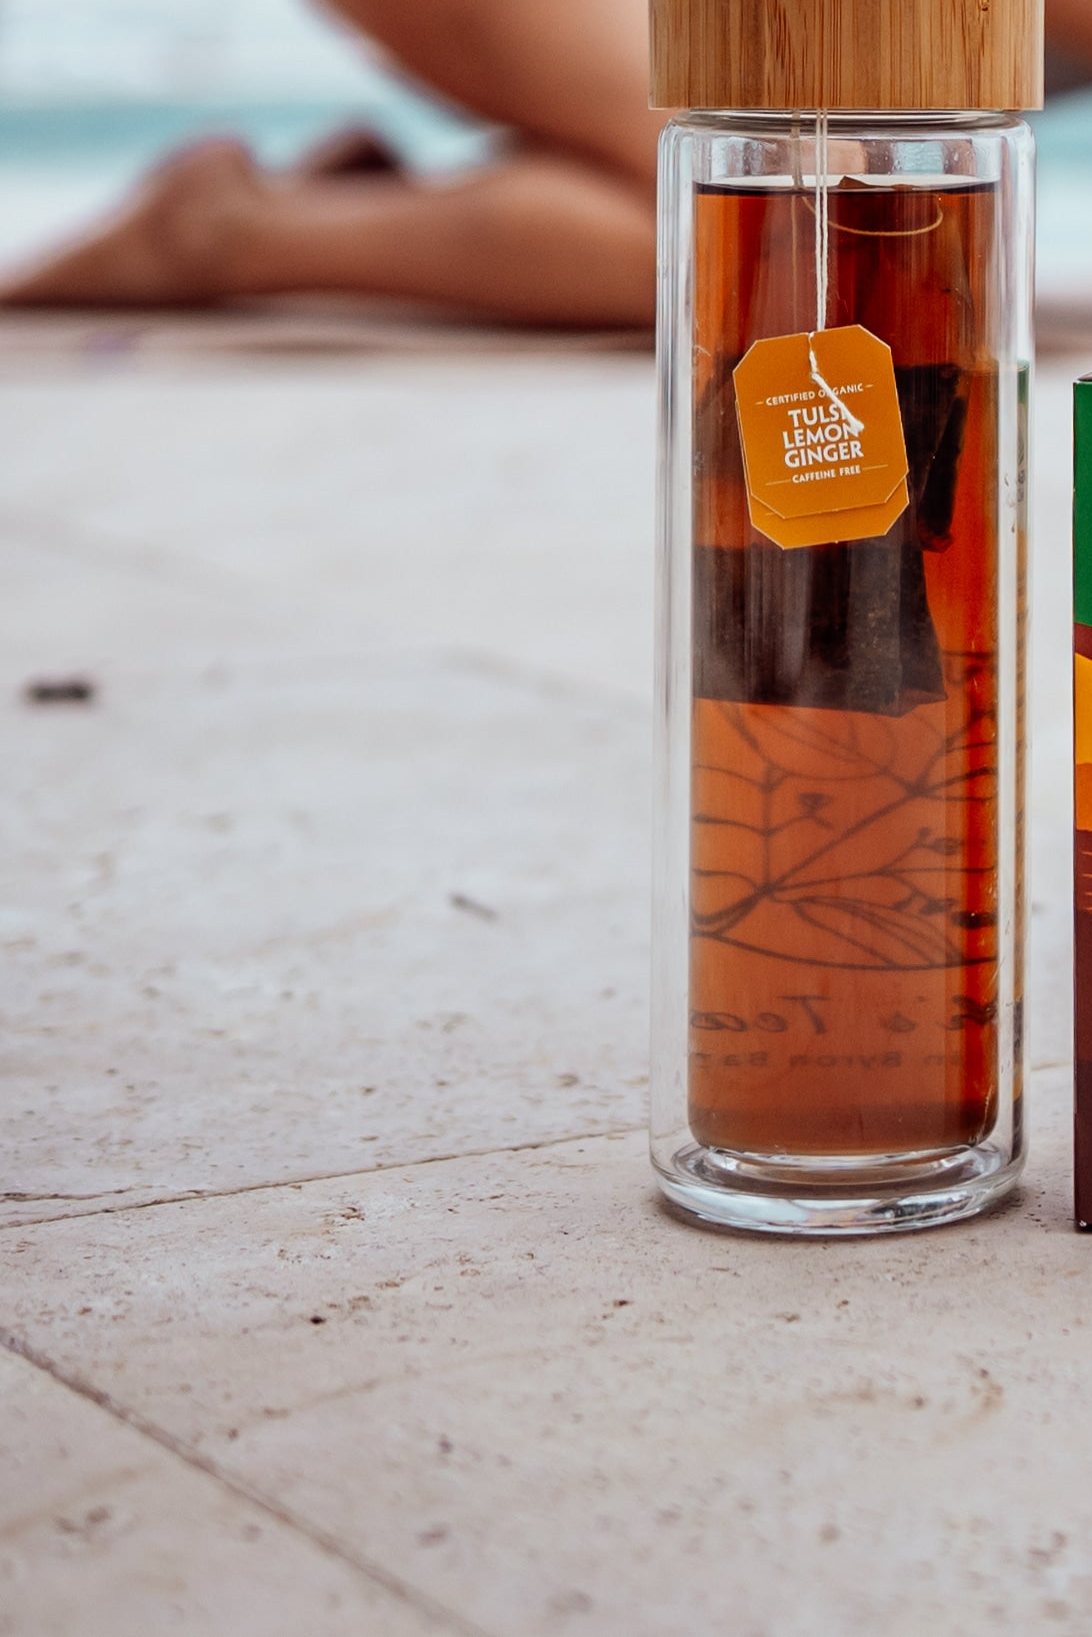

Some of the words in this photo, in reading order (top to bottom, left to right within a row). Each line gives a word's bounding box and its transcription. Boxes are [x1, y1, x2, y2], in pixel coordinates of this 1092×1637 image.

[766, 390, 815, 406] CERTIFIED
[818, 383, 864, 398] OGANIC
[784, 440, 864, 468] GINGER
[792, 468, 836, 483] CAFFEINE
[839, 464, 861, 476] FREE
